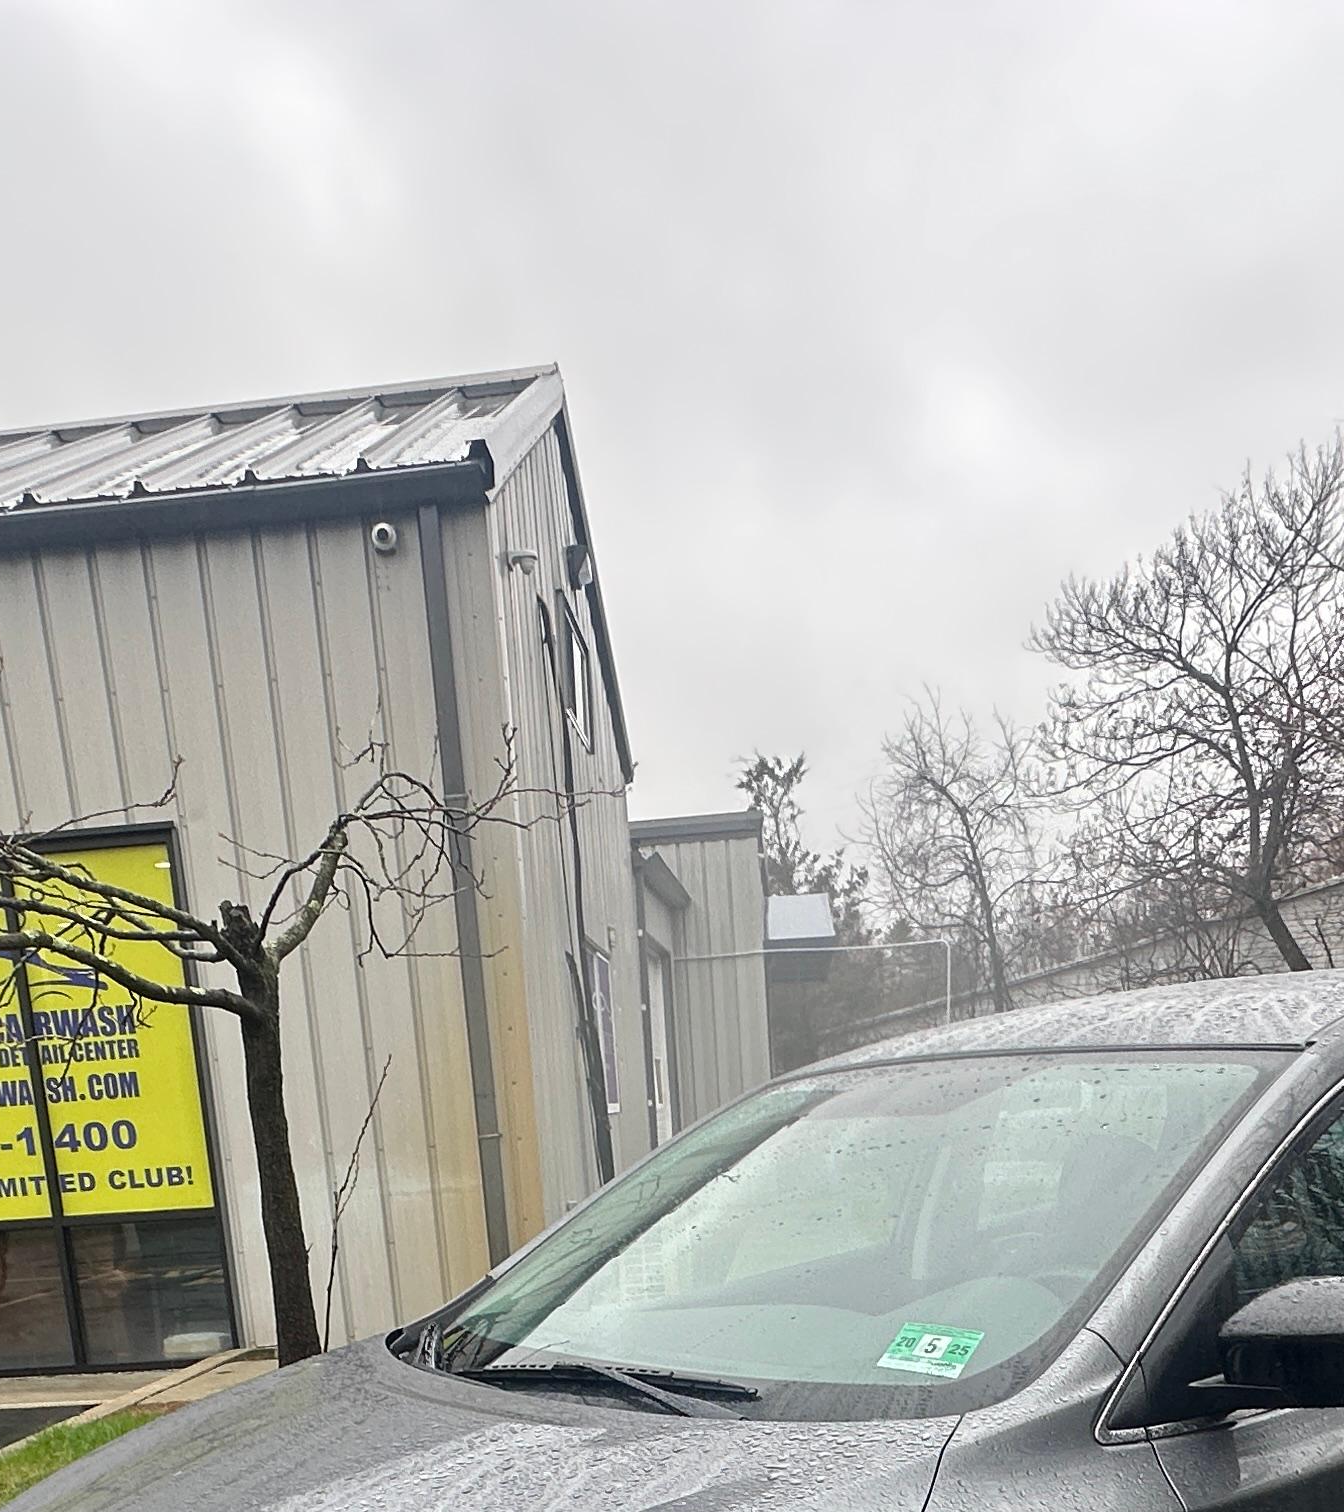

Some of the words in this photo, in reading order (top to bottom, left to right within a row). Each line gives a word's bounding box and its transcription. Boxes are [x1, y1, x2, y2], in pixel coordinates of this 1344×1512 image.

[72, 1038, 140, 1062] CENTER
[108, 1166, 194, 1190] CLUB!
[896, 1336, 918, 1348] 20
[924, 1338, 941, 1354] 5
[948, 1344, 971, 1357] 25
